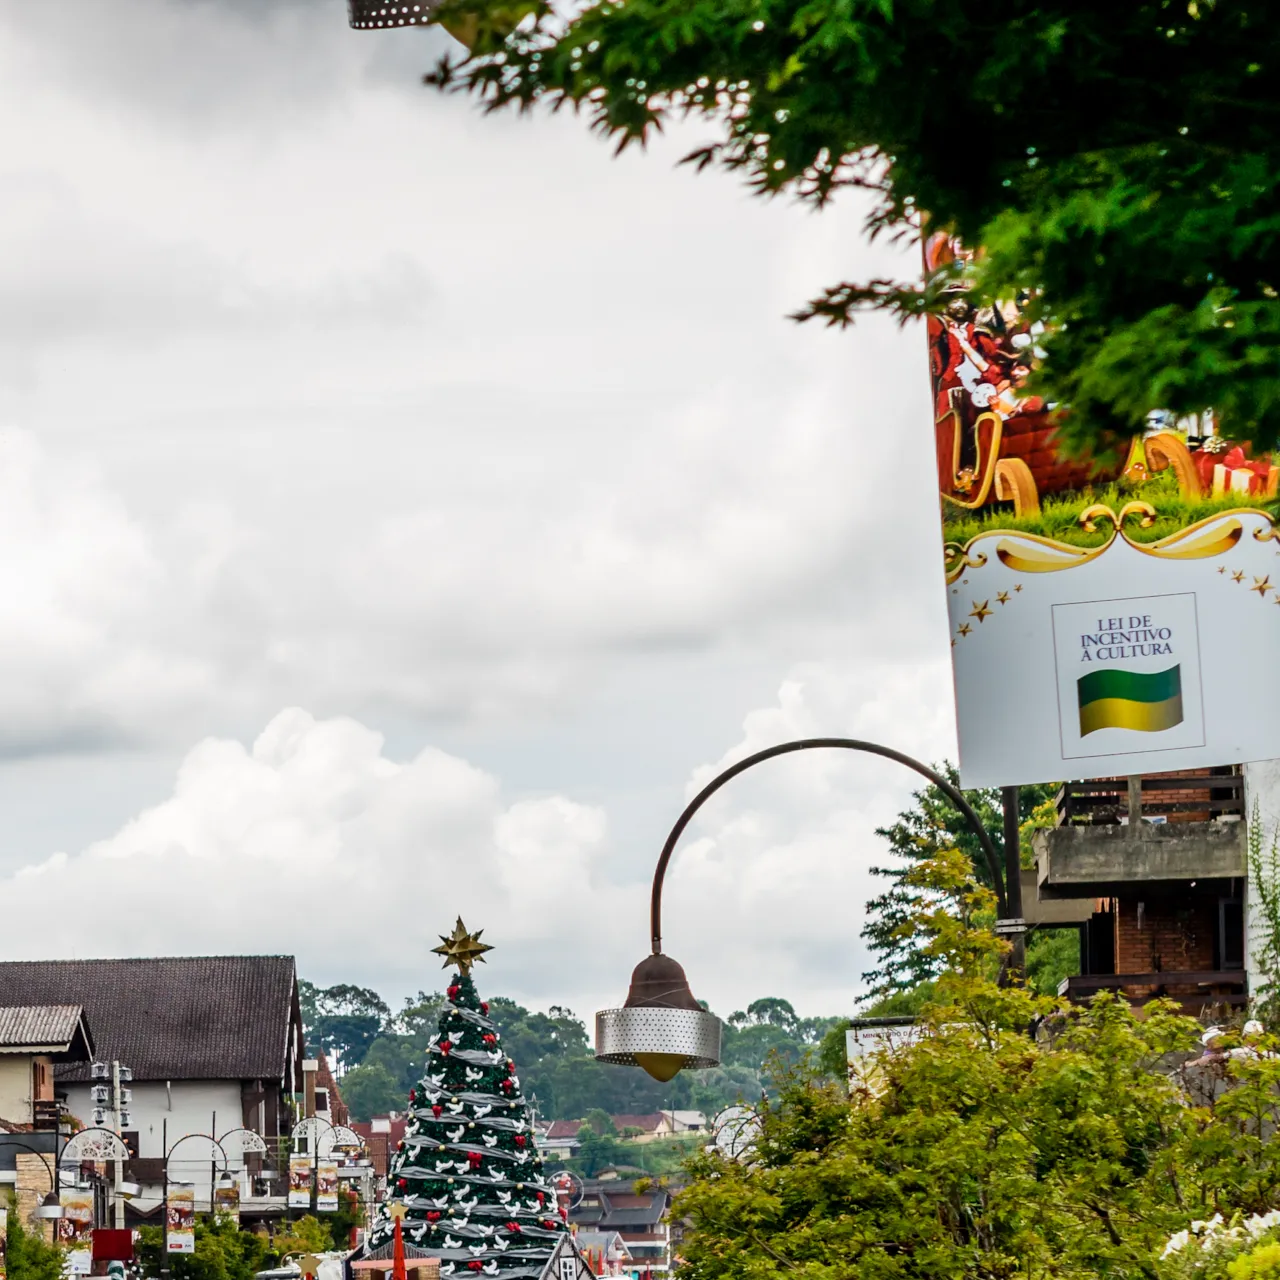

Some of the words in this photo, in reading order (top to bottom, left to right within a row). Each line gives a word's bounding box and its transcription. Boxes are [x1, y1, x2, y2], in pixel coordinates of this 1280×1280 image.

[1097, 617, 1124, 632] LEI
[1128, 614, 1153, 629] DE
[1080, 627, 1172, 648] INCENTIVO
[1080, 646, 1092, 662] À
[1096, 642, 1173, 660] CULTURA
